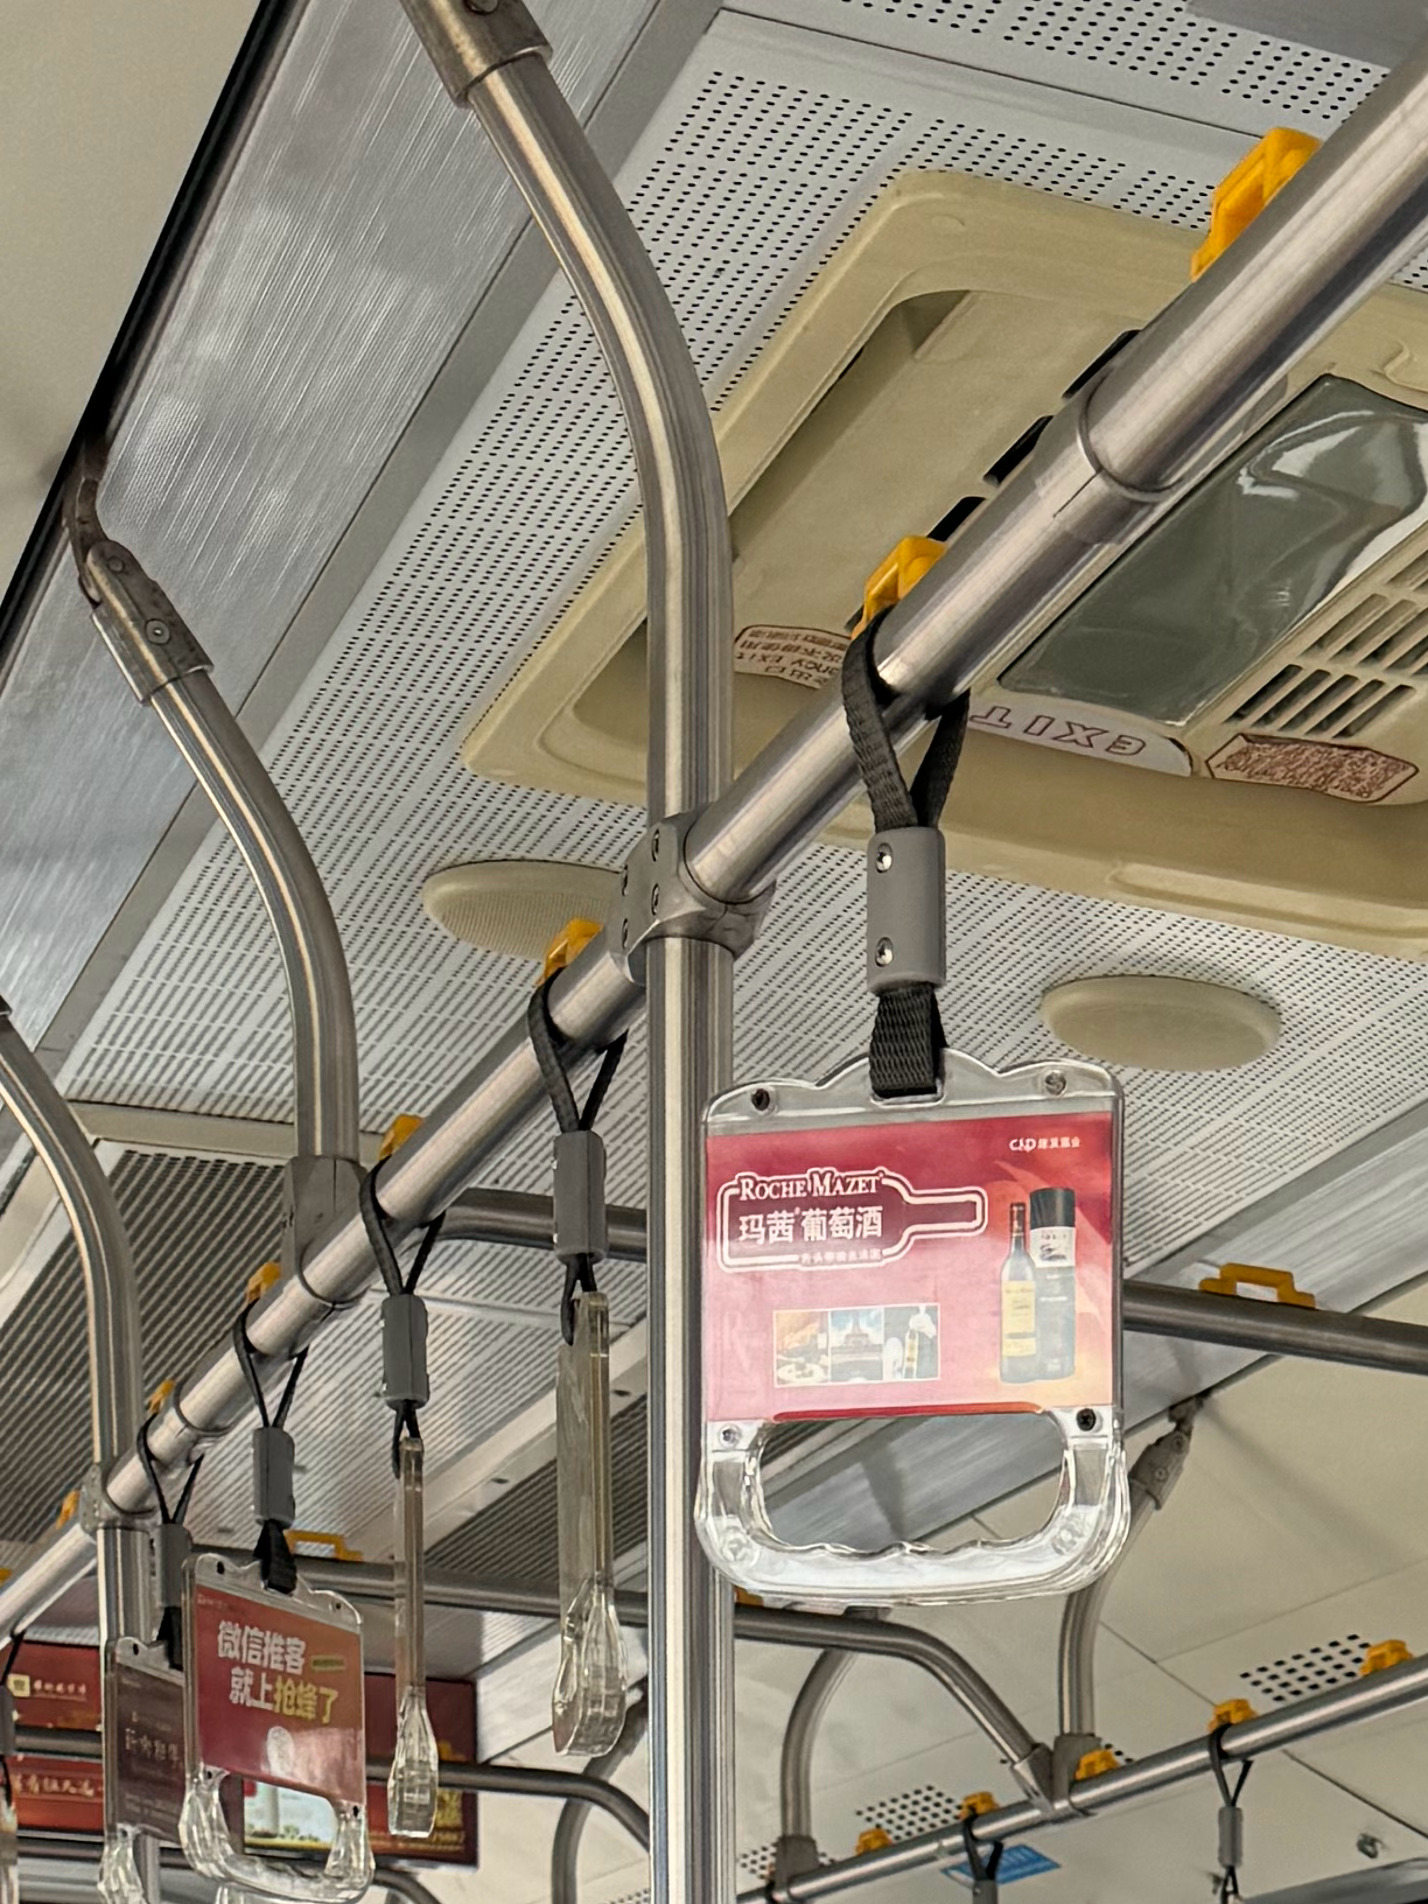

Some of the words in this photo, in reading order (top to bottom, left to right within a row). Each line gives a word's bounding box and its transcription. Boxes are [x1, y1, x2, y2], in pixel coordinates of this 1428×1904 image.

[969, 705, 1147, 757] EXIT
[738, 1176, 808, 1201] ROCHE
[811, 1173, 880, 1197] MAZET
[217, 1620, 307, 1676] 微信推客
[229, 1666, 339, 1724] 就上抢蜂了
